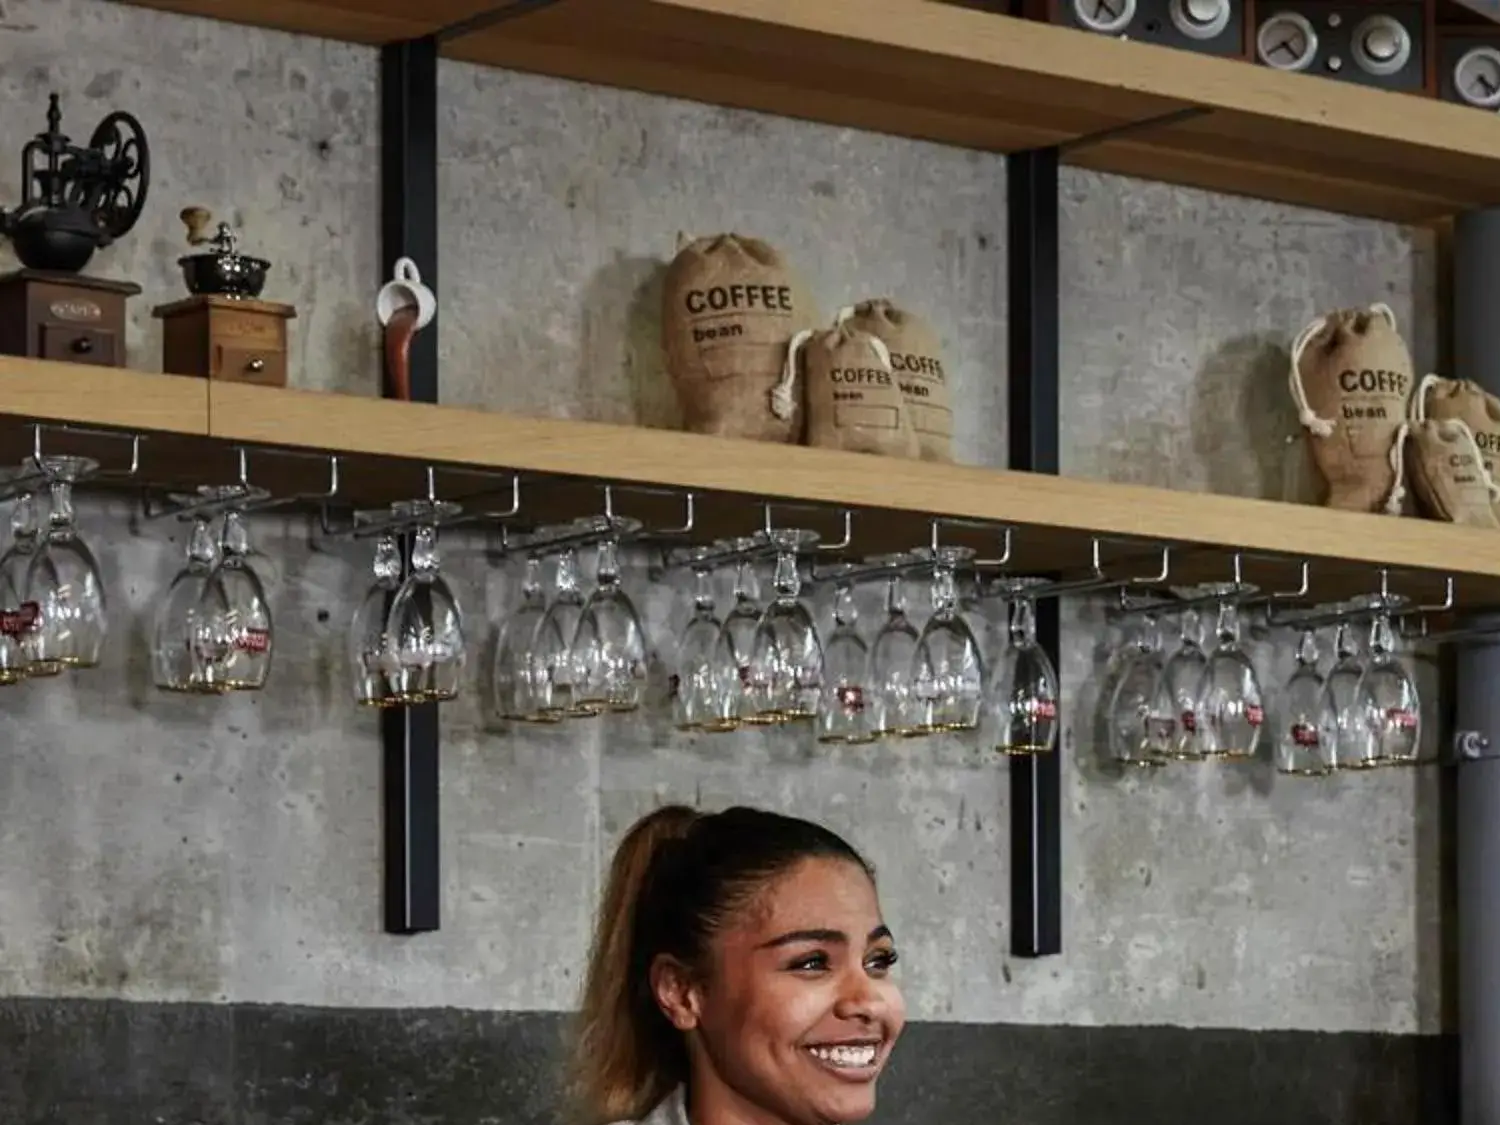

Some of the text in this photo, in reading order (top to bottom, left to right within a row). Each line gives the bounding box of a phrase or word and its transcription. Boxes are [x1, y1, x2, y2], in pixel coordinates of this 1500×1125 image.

[685, 285, 792, 314] COFFEE
[693, 324, 743, 343] bean
[1342, 403, 1387, 420] bean
